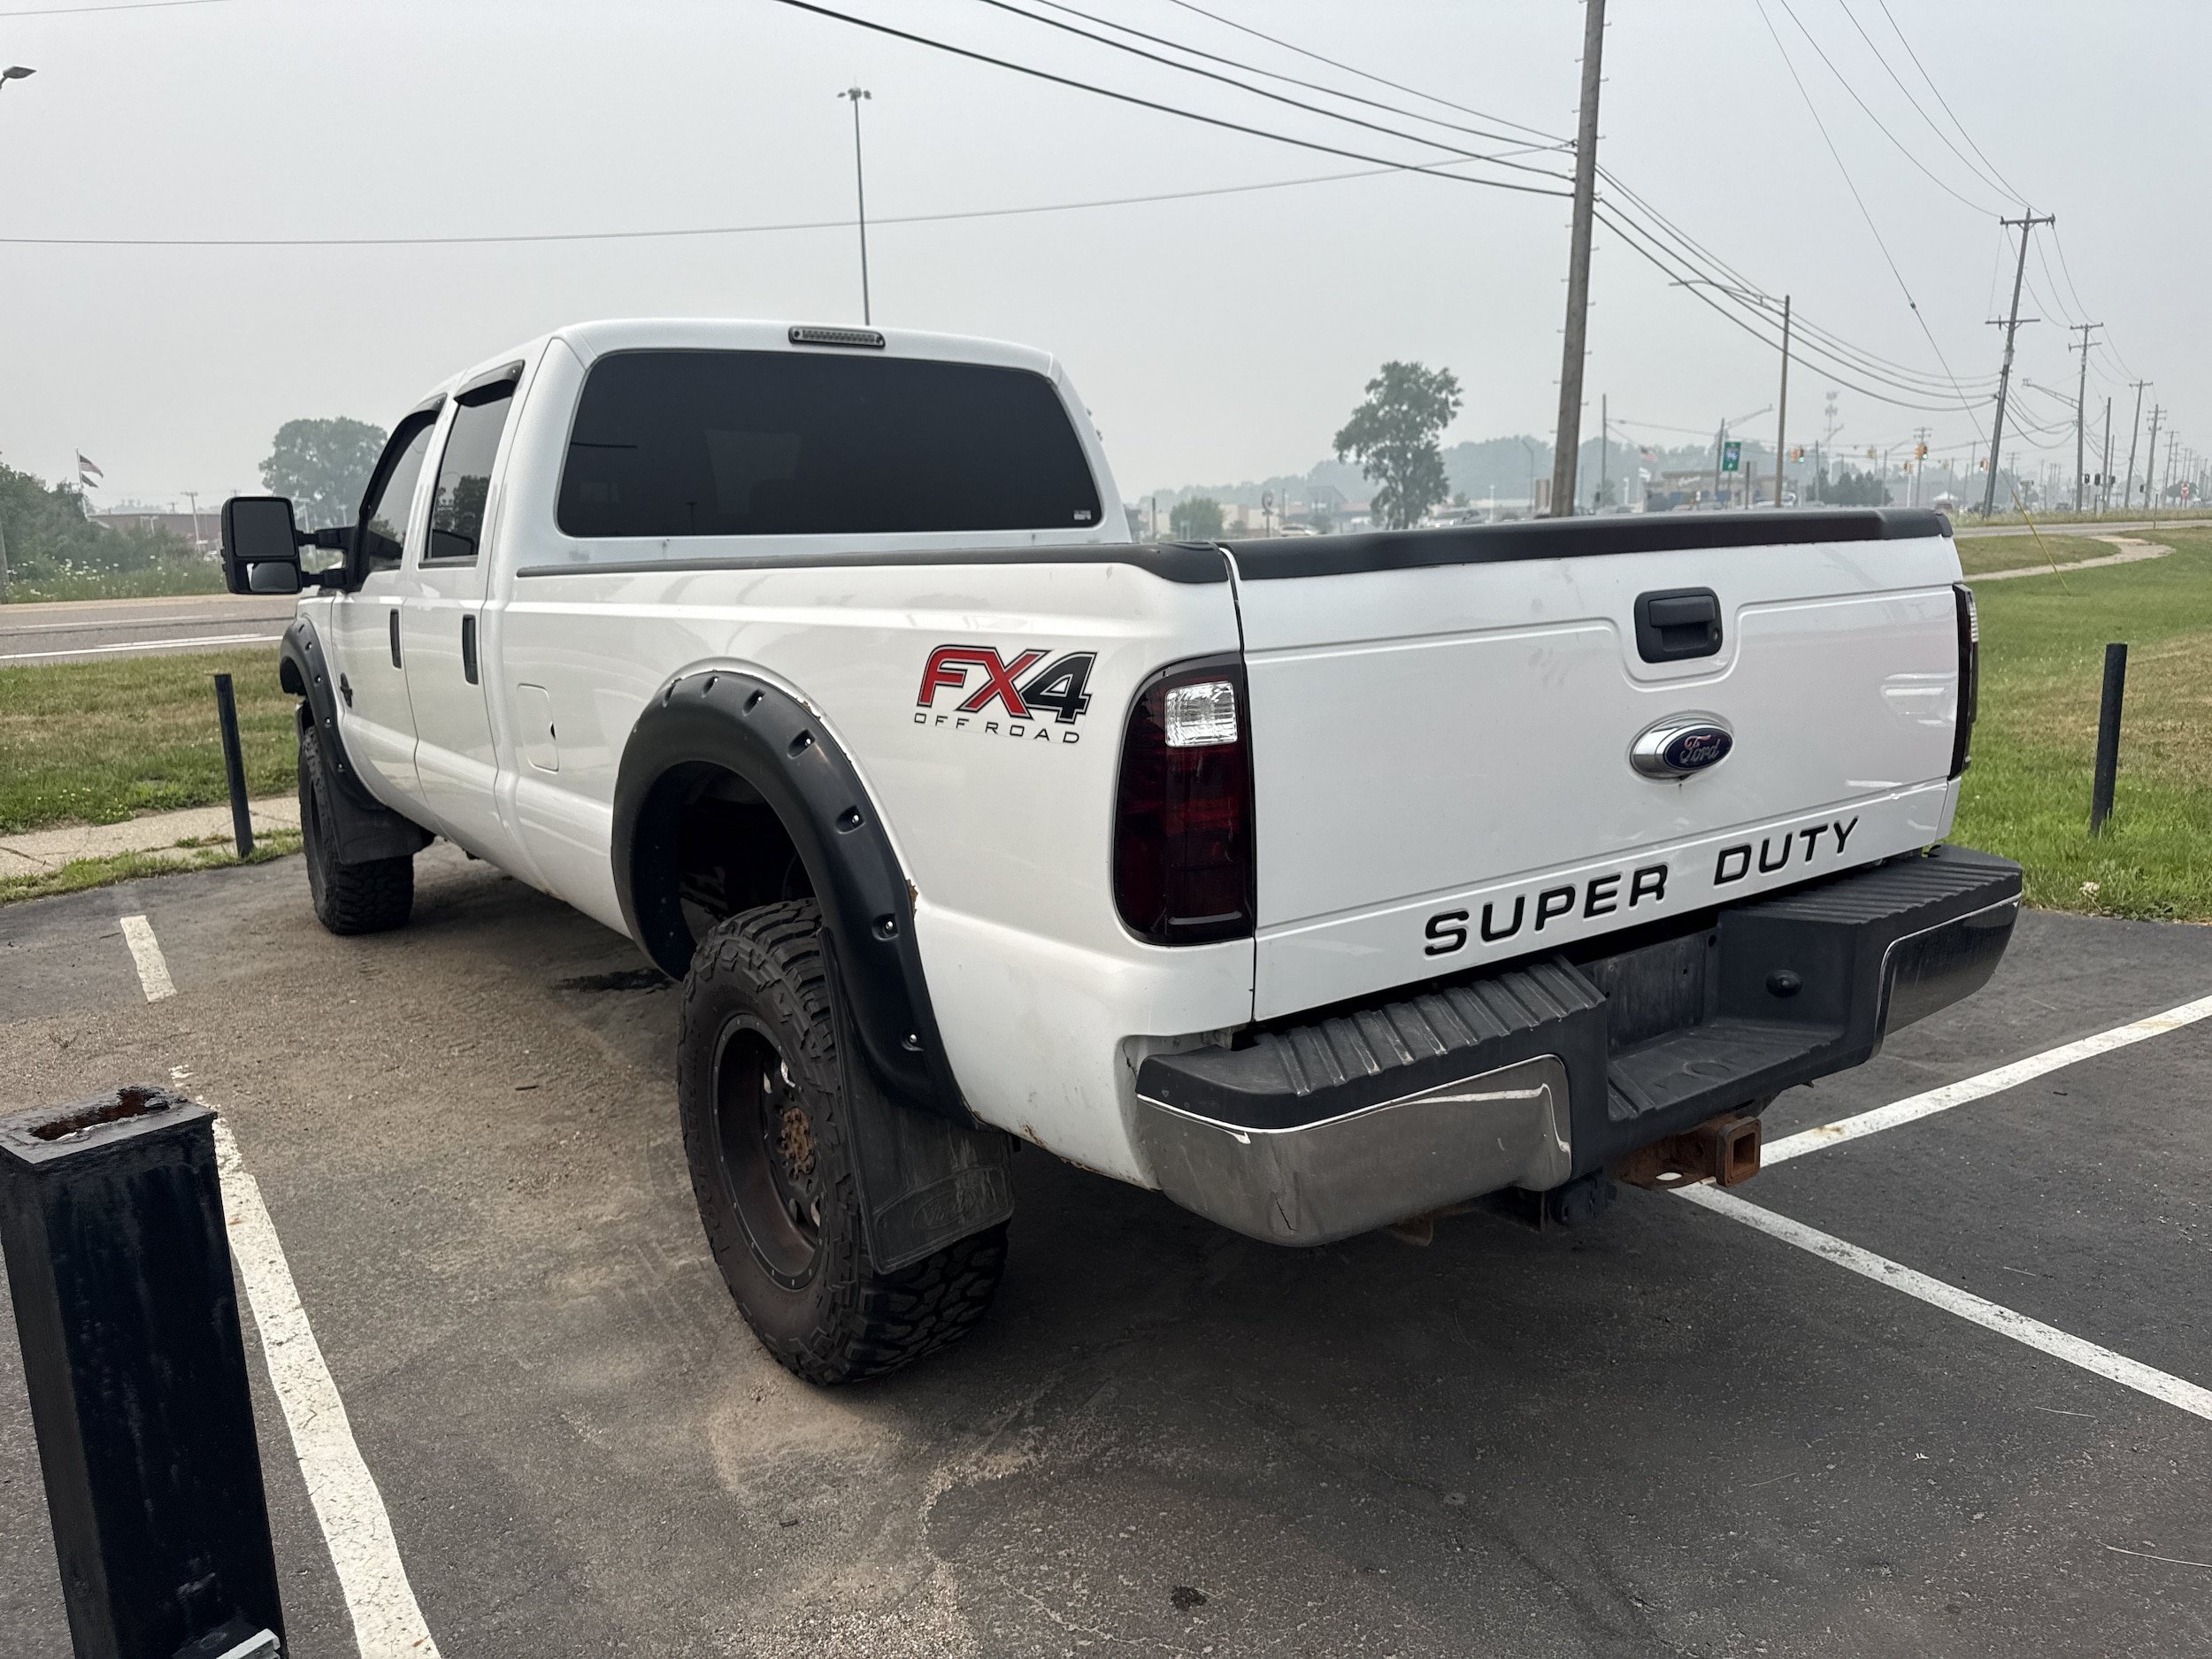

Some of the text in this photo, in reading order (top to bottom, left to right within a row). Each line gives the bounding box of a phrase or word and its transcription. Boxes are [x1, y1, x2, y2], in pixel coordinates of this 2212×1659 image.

[917, 644, 1098, 725] FX4
[914, 712, 1080, 744] OFF ROAD
[1679, 733, 1721, 764] Ford
[1424, 816, 1859, 957] SUPER DUTY
